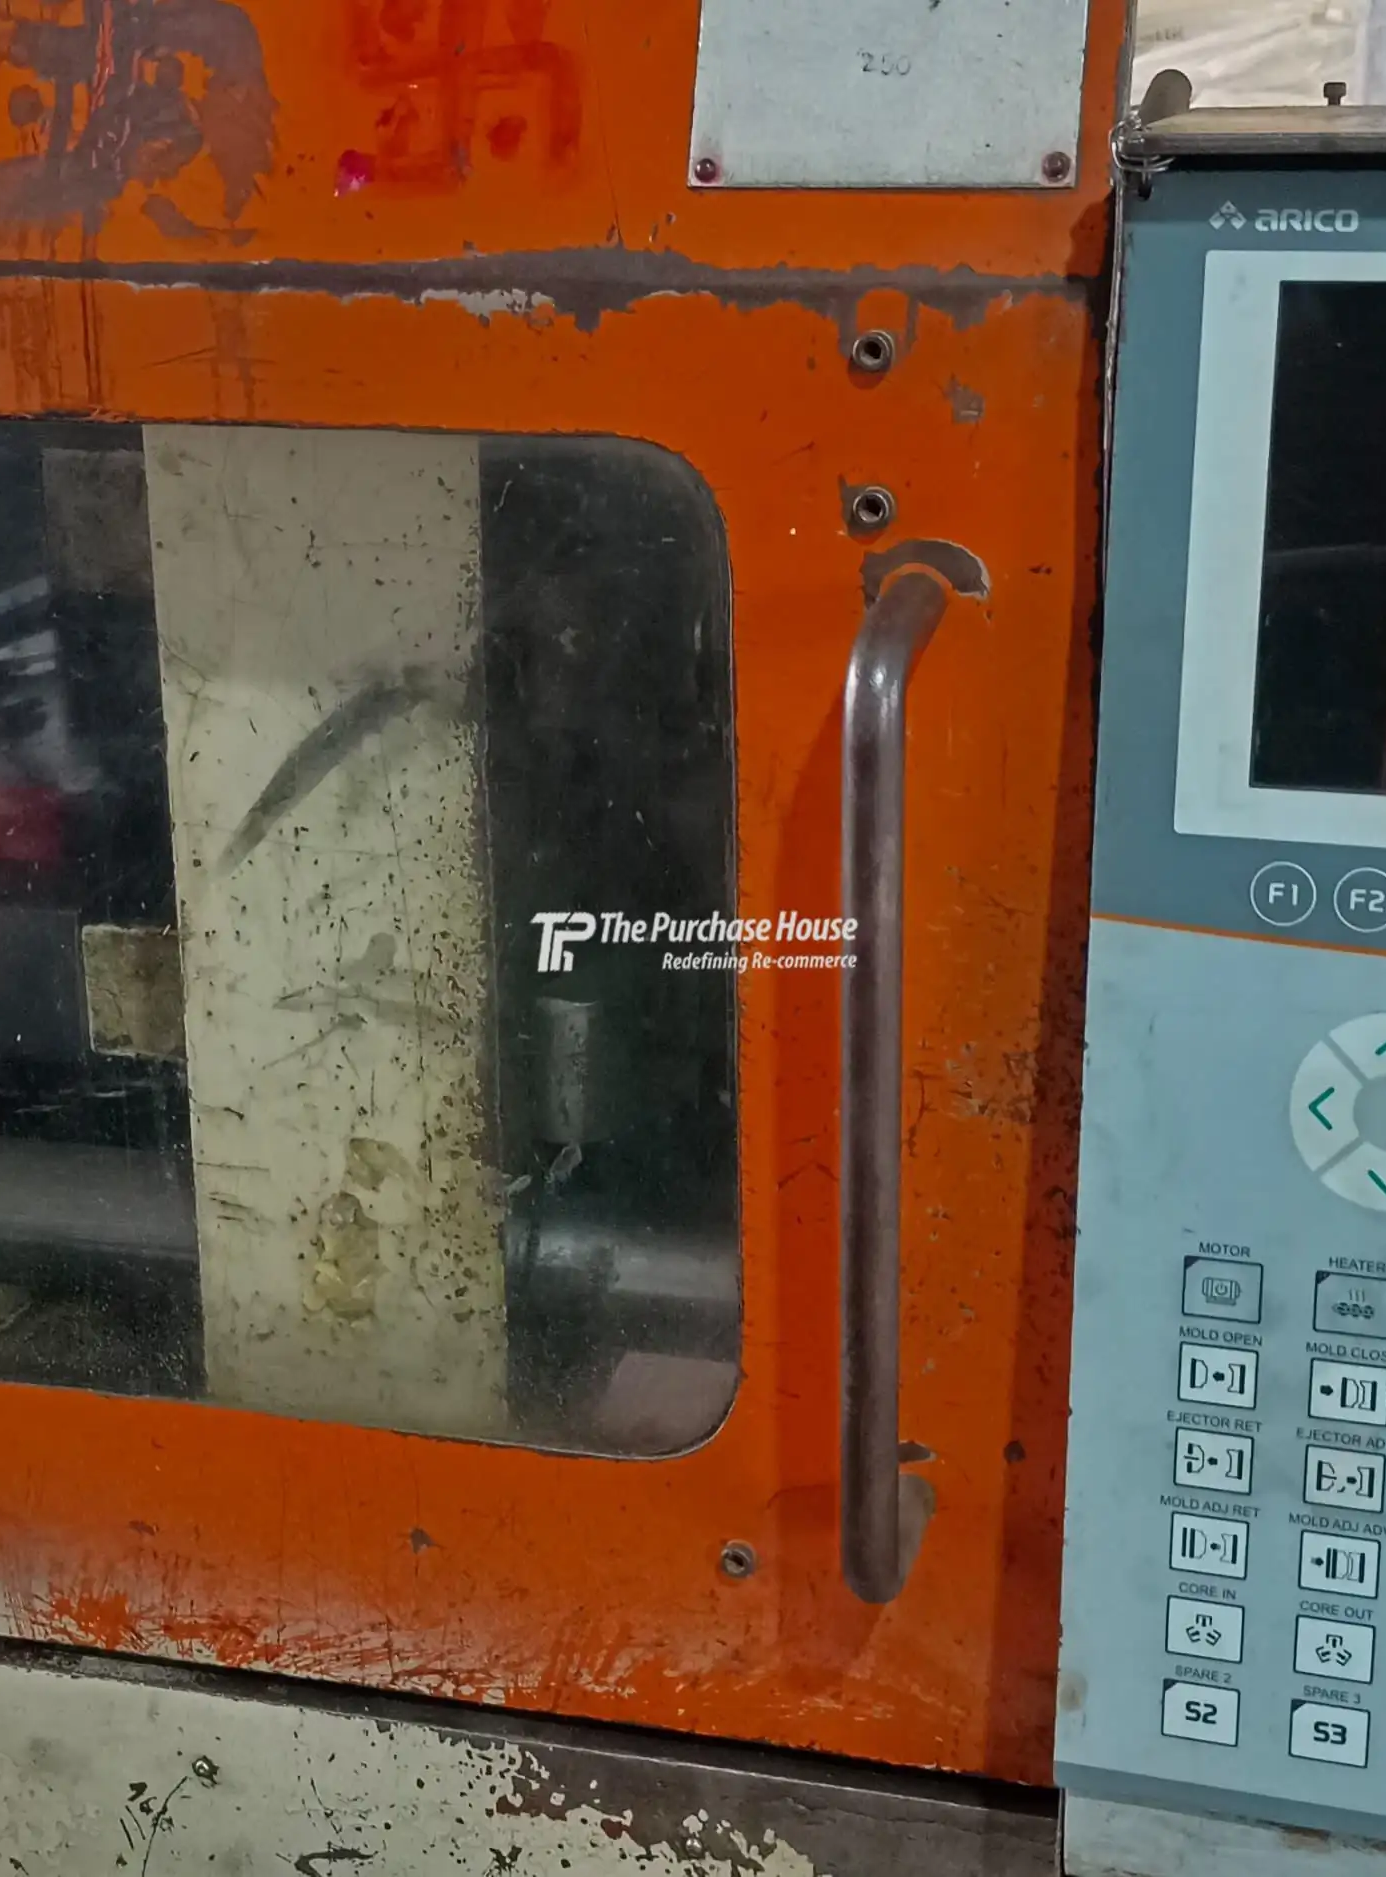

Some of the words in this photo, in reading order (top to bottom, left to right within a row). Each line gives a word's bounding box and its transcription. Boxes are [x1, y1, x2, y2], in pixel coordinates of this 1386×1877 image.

[1268, 882, 1299, 906] F1
[1348, 888, 1386, 913] F2
[1198, 1241, 1251, 1258] MOTOR
[1328, 1256, 1386, 1273] HEATER
[1179, 1325, 1219, 1342] MOLD
[1222, 1330, 1263, 1347] OPEN
[1305, 1341, 1347, 1357] MOLD
[1166, 1410, 1232, 1428] EJECTOR
[1234, 1418, 1263, 1433] RET
[1295, 1427, 1361, 1446] EJECTOR
[1160, 1494, 1200, 1510] MOLD
[1202, 1500, 1229, 1515] ADJ
[1232, 1503, 1261, 1518] RET
[1288, 1512, 1330, 1528] MOLD
[1332, 1518, 1360, 1533] ADJ
[1178, 1581, 1219, 1597] CORE
[1221, 1588, 1238, 1600] IN
[1299, 1599, 1341, 1616] CORE
[1343, 1606, 1374, 1621] OUT
[1174, 1665, 1220, 1683] SPARE
[1222, 1672, 1233, 1684] 2
[1302, 1685, 1350, 1703] SPARE
[1352, 1693, 1362, 1705] 3
[1184, 1700, 1218, 1725] S2
[1312, 1720, 1347, 1745] S3
